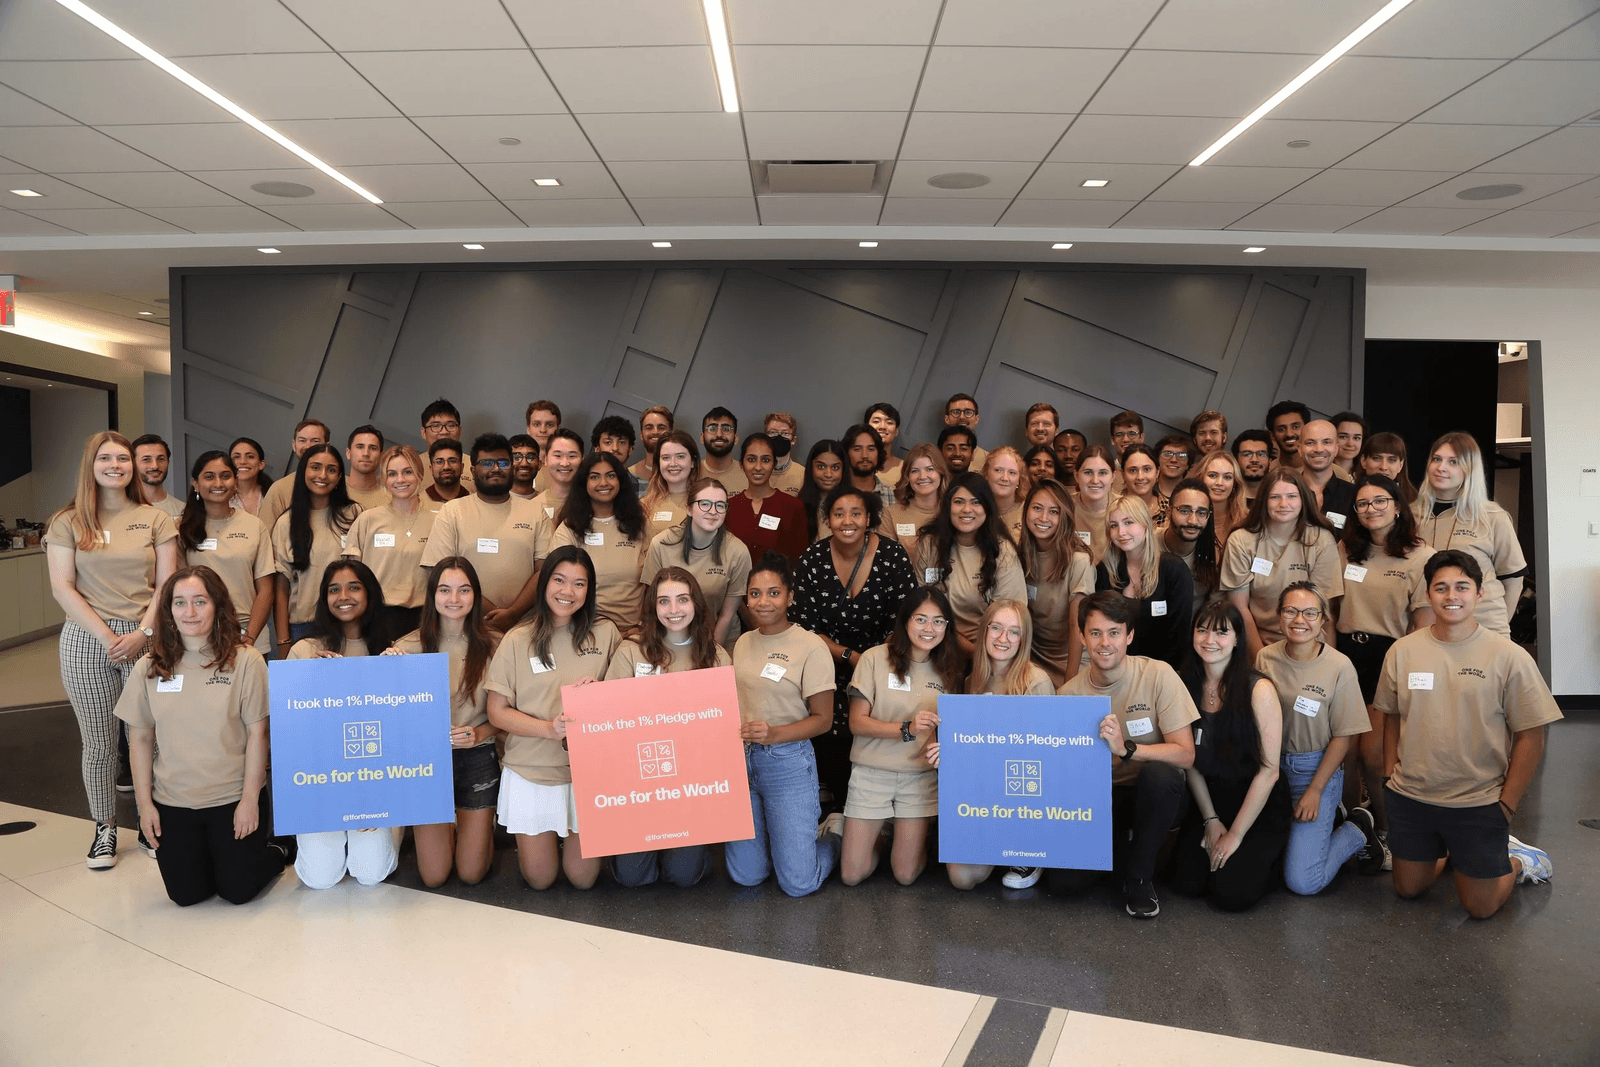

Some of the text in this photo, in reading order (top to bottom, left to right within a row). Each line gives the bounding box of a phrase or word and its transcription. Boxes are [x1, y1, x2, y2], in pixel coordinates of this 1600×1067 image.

[287, 691, 434, 710] I took the 1% Pledge with
[582, 707, 723, 734] I took the 1% Pledge with
[953, 732, 1094, 748] I took the 1% Pledge with
[293, 763, 434, 786] One for the World
[594, 779, 730, 808] One for the World
[342, 811, 389, 822] @1fortheworld
[957, 803, 1092, 822] One for the World
[645, 831, 689, 842] @1fortheworld
[1002, 849, 1047, 858] @1fortheworld
